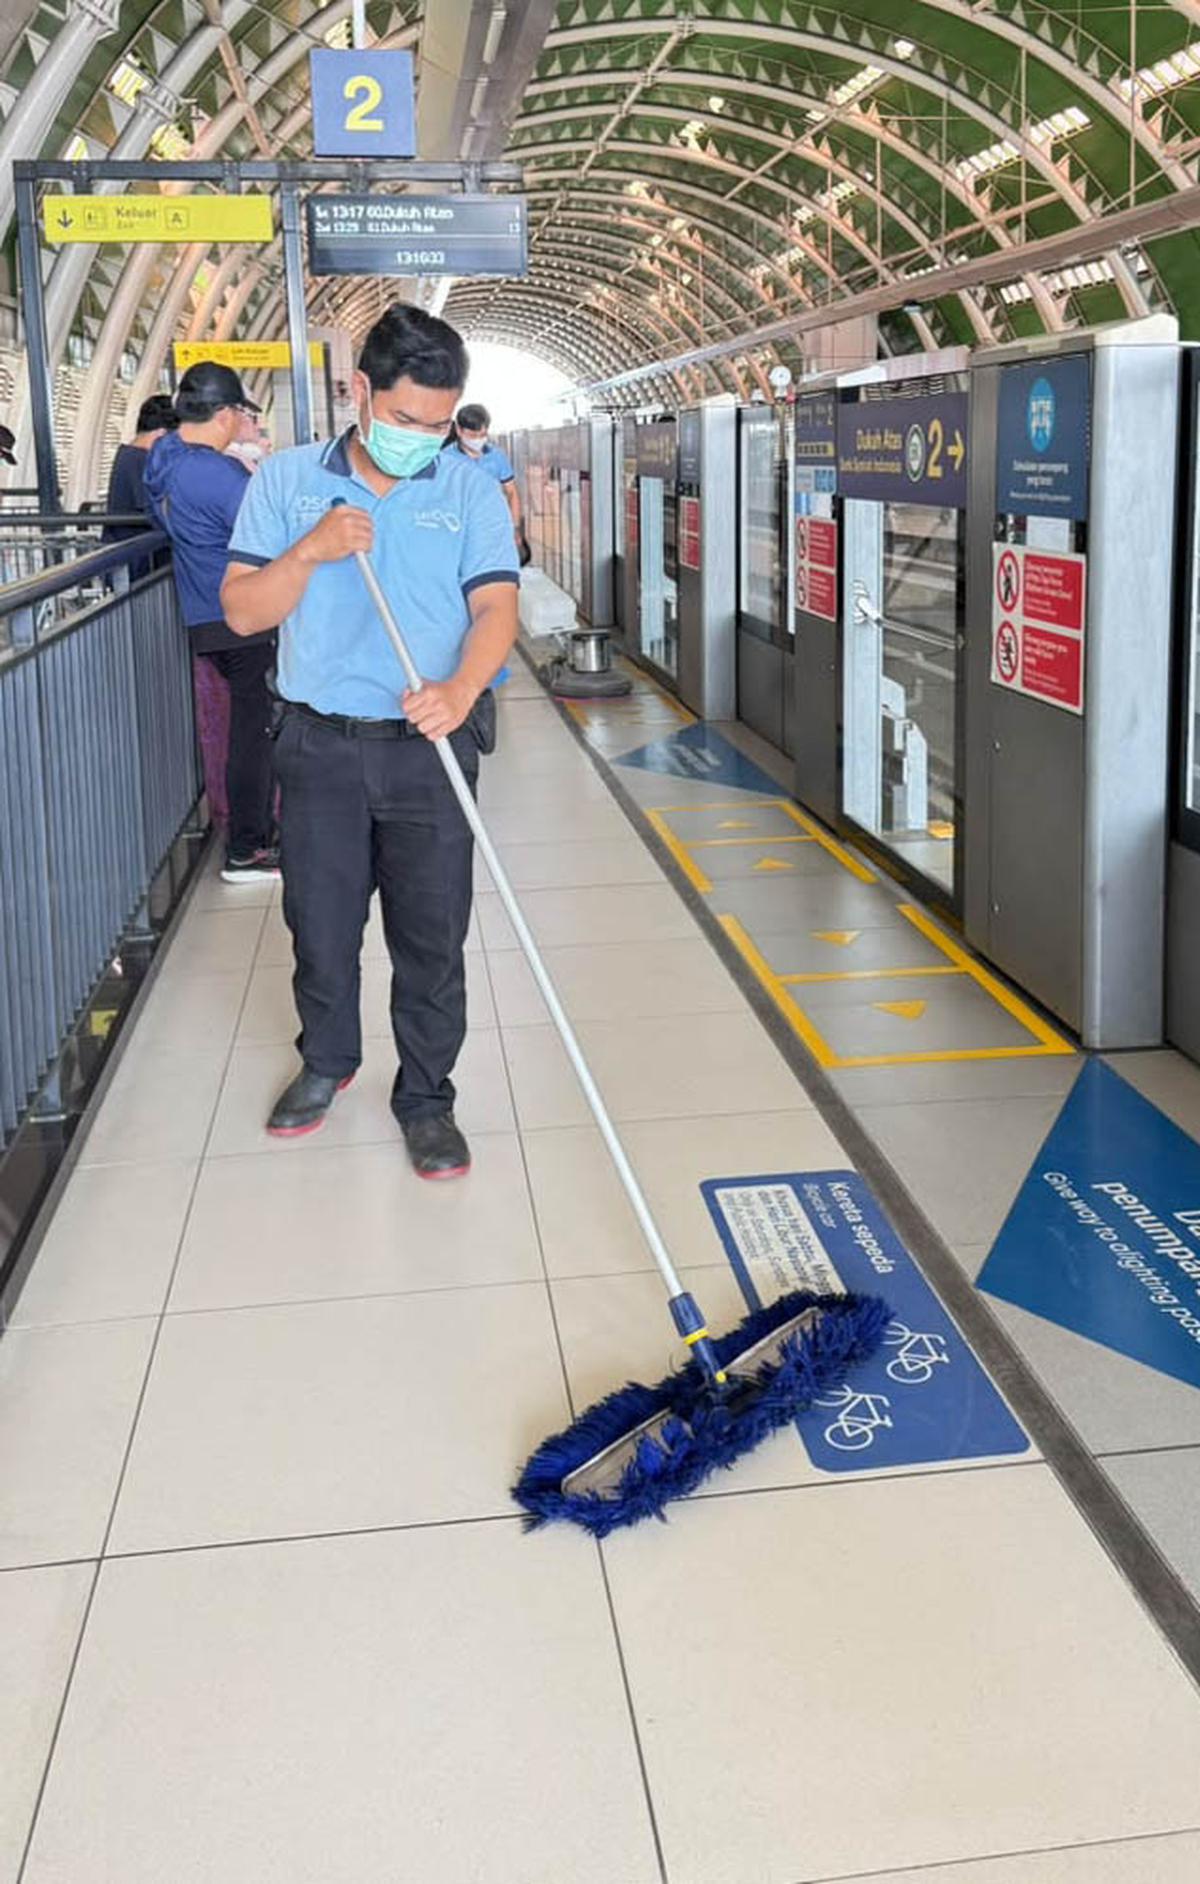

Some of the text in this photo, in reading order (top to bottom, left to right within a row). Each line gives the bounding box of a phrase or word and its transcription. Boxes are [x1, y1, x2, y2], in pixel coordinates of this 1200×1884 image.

[344, 75, 384, 131] 2
[171, 212, 182, 224] A
[926, 417, 944, 479] 2
[827, 1181, 896, 1274] Kereta sepeda
[1043, 1171, 1077, 1200] Give
[1071, 1195, 1105, 1226] way
[1094, 1224, 1119, 1242] to
[1109, 1241, 1179, 1307] alighting
[1091, 1181, 1200, 1297] penumpa
